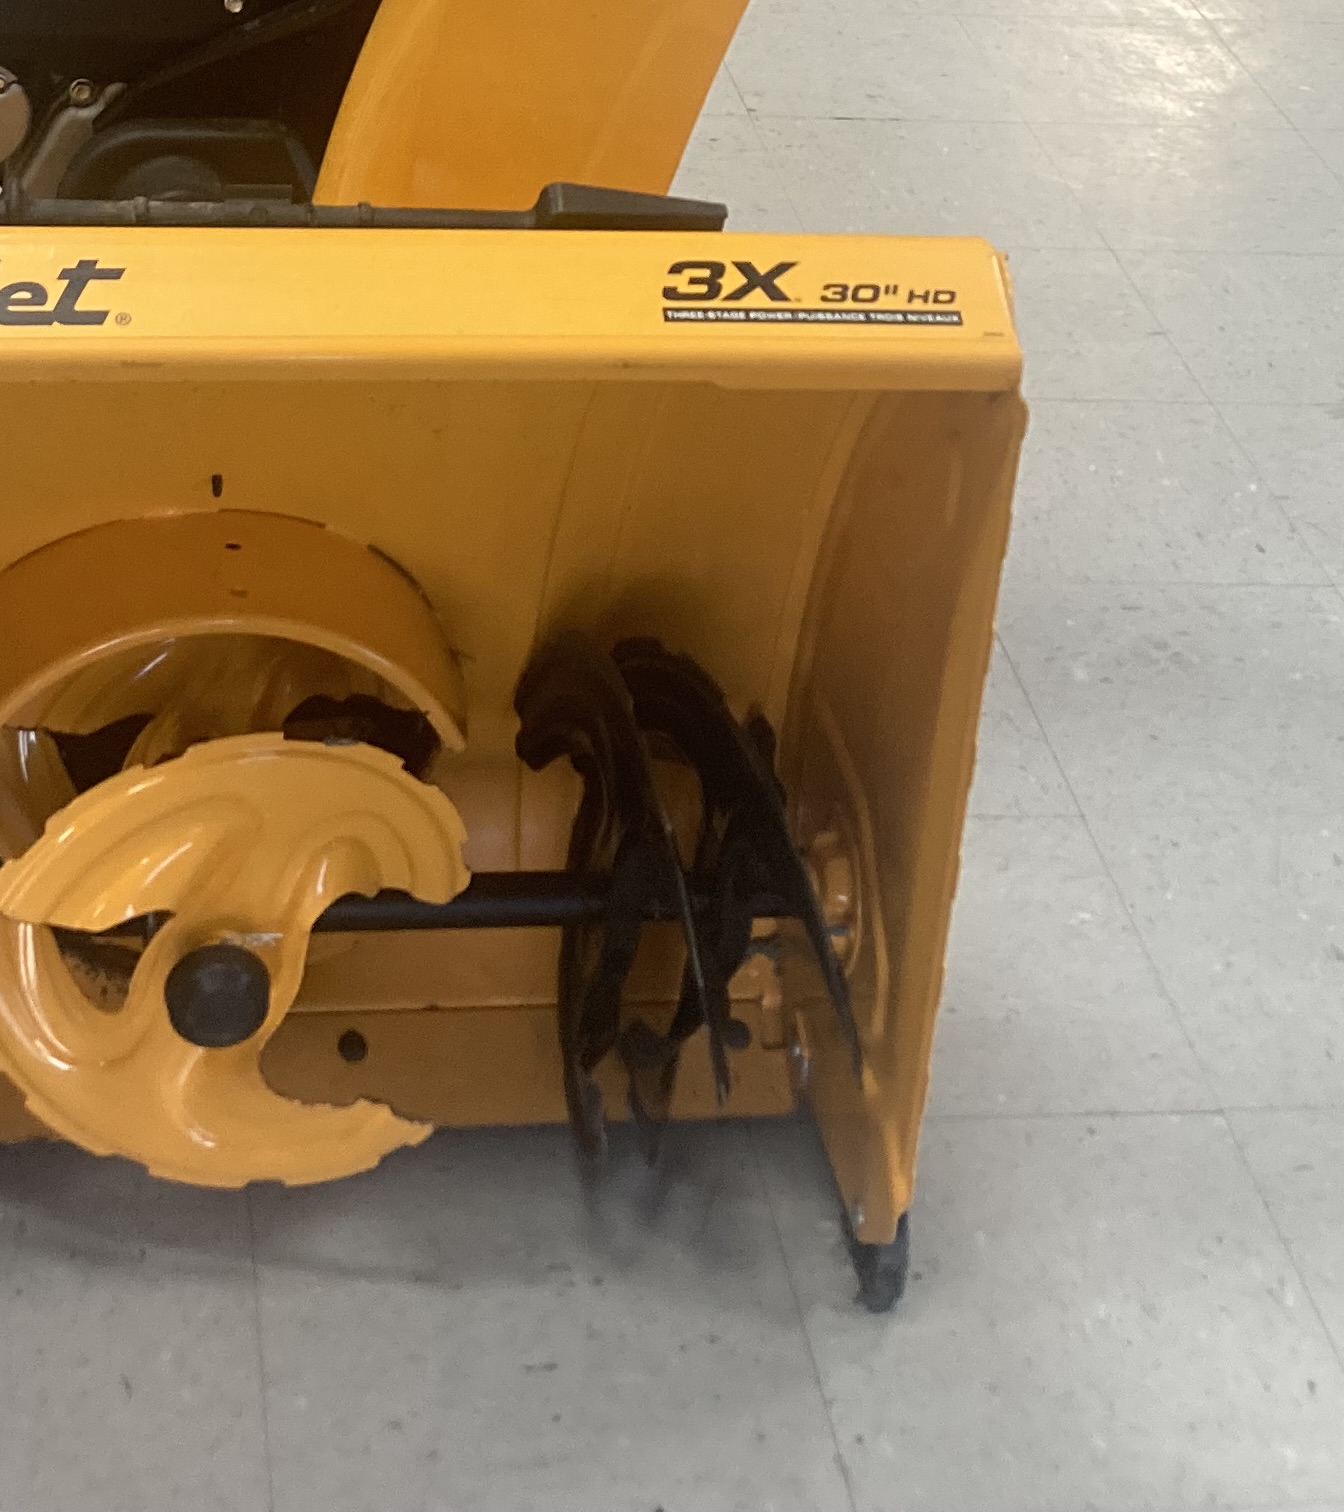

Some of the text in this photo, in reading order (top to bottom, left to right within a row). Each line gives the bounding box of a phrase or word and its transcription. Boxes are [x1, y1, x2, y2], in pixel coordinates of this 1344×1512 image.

[662, 261, 957, 304] 3X 30" HD
